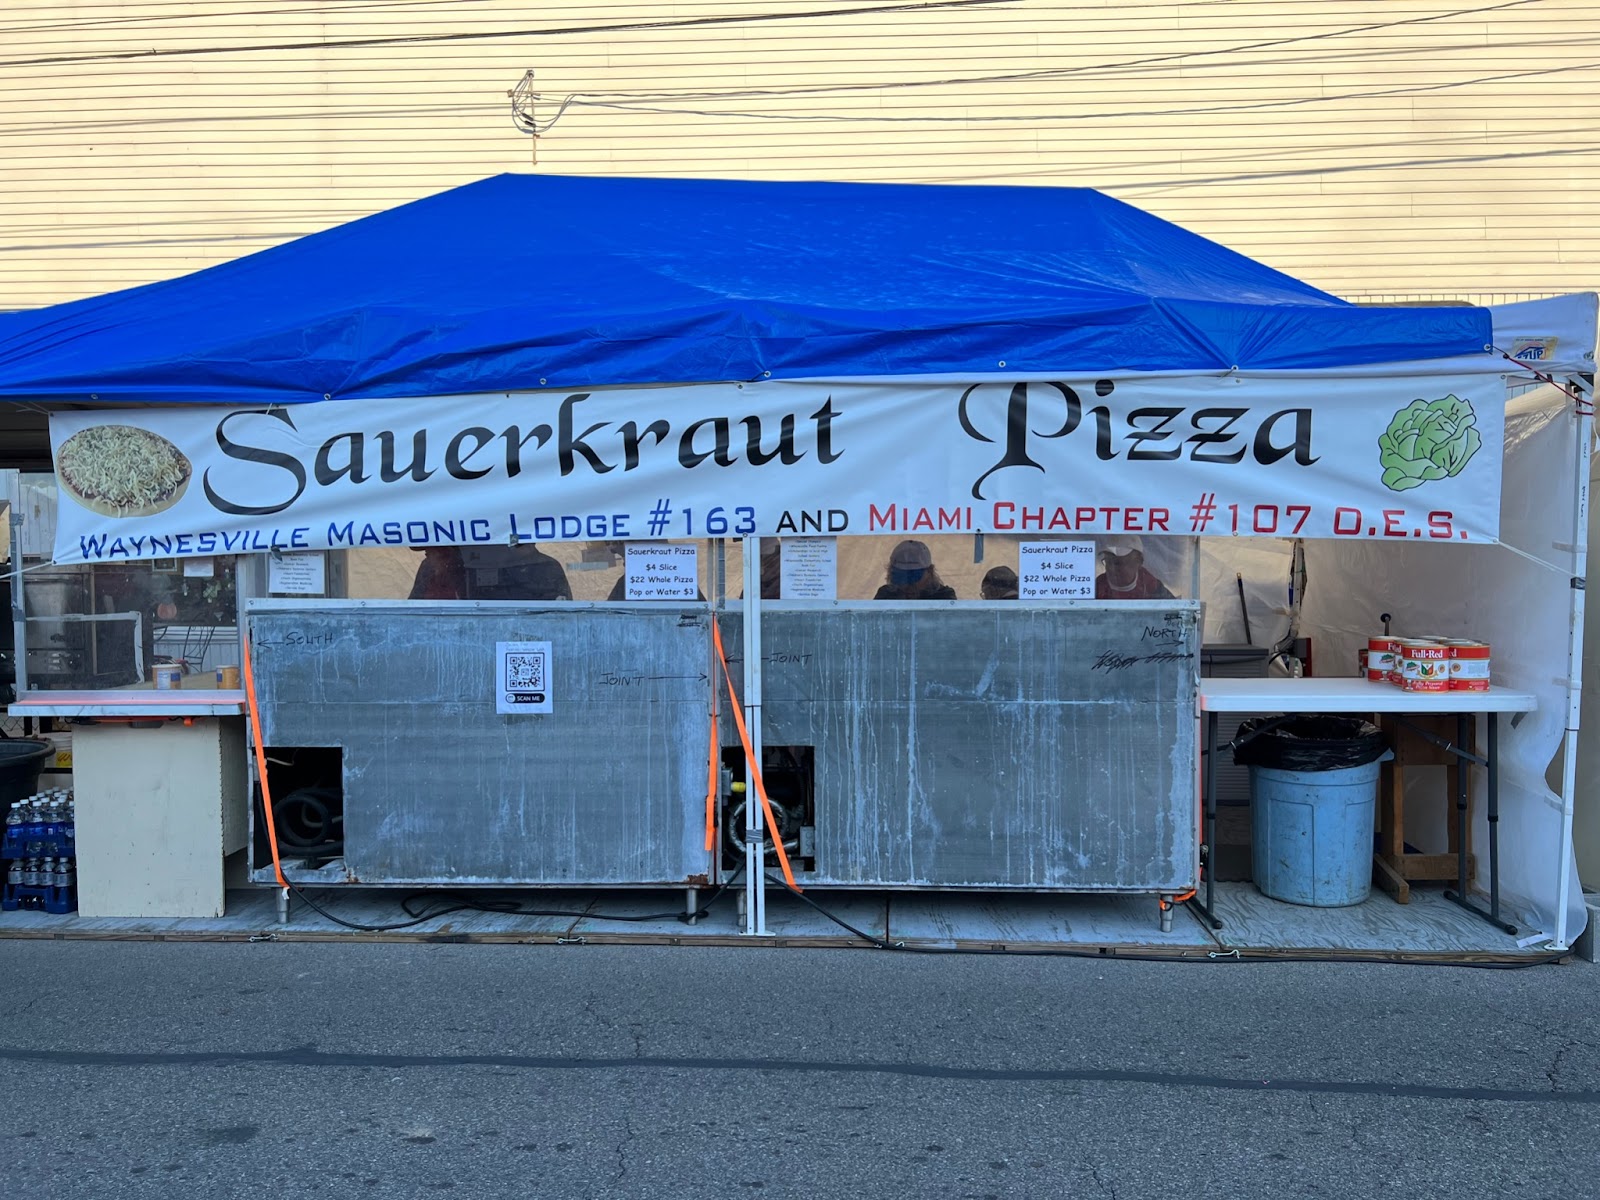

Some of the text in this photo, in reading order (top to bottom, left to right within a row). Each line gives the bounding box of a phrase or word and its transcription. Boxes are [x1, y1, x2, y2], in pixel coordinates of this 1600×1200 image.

[203, 379, 1321, 516] Sauerkraut Pizza
[80, 492, 1468, 559] WAYNESVILLE MASONIC LODGE #163 AND MIAMI CHAPTER #107 O.E.S.
[674, 547, 695, 555] Pizza
[1071, 545, 1093, 553] Pizza
[1041, 562, 1051, 570] $4
[630, 576, 645, 584] $22
[1024, 575, 1039, 583] $22
[629, 588, 642, 597] Pop
[656, 588, 680, 596] Water
[683, 588, 694, 596] $3
[1023, 587, 1036, 596] Pop
[1051, 587, 1077, 595] Water
[1080, 587, 1091, 596] $3
[1141, 626, 1188, 641] NORTH
[286, 631, 333, 646] SOUTH
[769, 652, 812, 664] JOINT
[599, 672, 645, 687] JOINT
